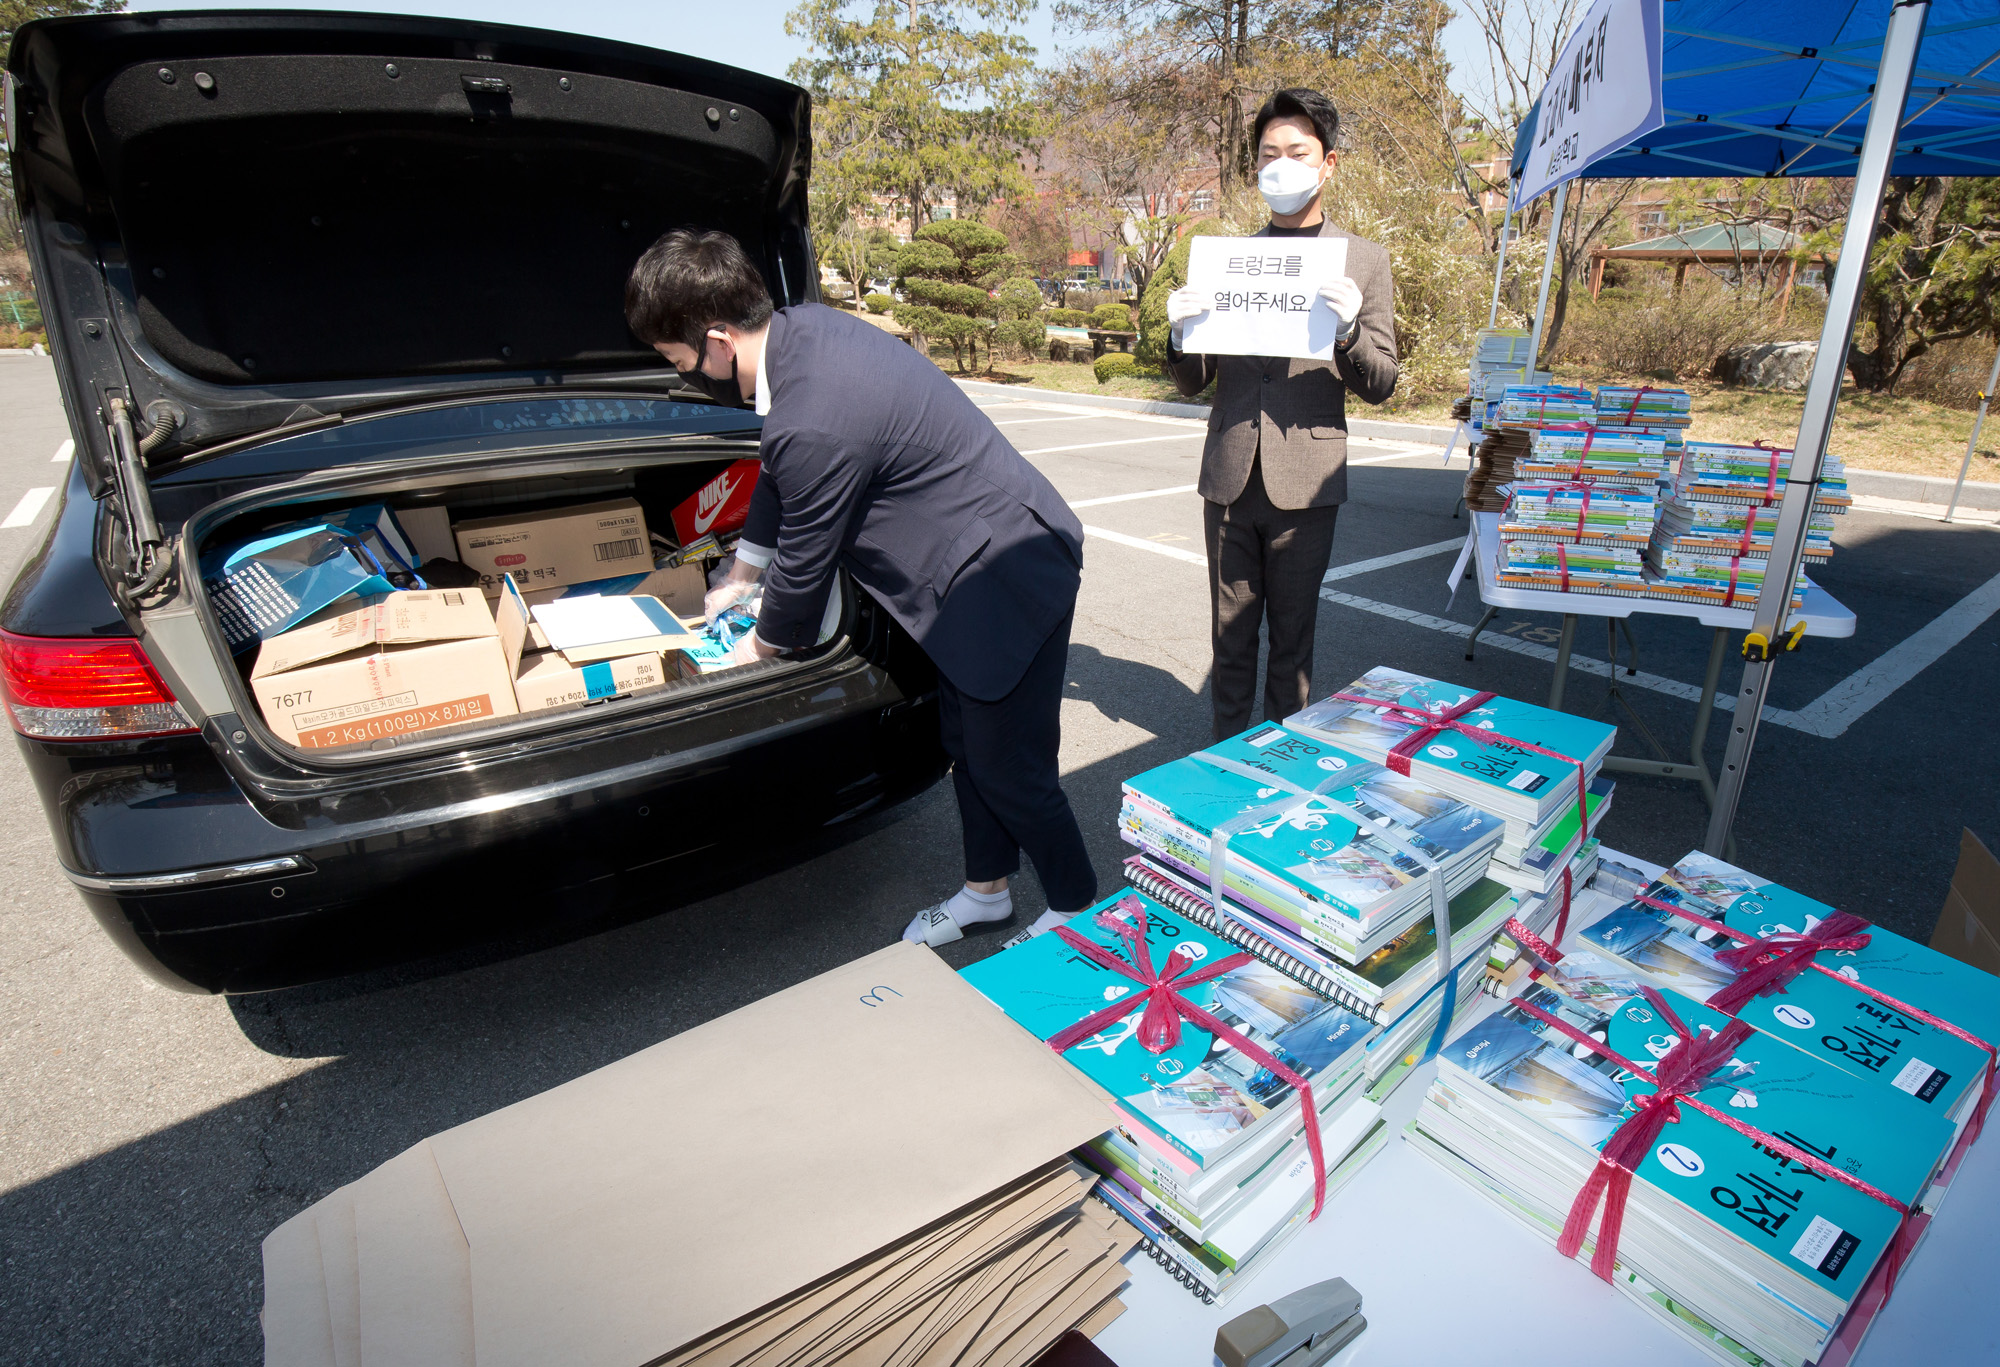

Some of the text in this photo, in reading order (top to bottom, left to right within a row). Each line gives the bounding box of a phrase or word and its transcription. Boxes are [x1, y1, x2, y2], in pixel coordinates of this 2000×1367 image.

[1226, 255, 1303, 277] 트렁크를
[1214, 290, 1312, 314] 열어주세요.
[698, 470, 730, 514] NIKE
[533, 566, 557, 580] 떡국
[636, 664, 653, 676] 10입
[634, 674, 655, 686] 메디안
[567, 690, 587, 701] 120g
[587, 686, 603, 697] 치약
[271, 690, 314, 710] 7677
[545, 696, 559, 707] 3입
[1321, 758, 1344, 770] 2
[1180, 943, 1204, 959] 2
[1776, 1006, 1811, 1026] 2
[1661, 1146, 1699, 1172] 2
[1288, 1160, 1309, 1179] 비상교육
